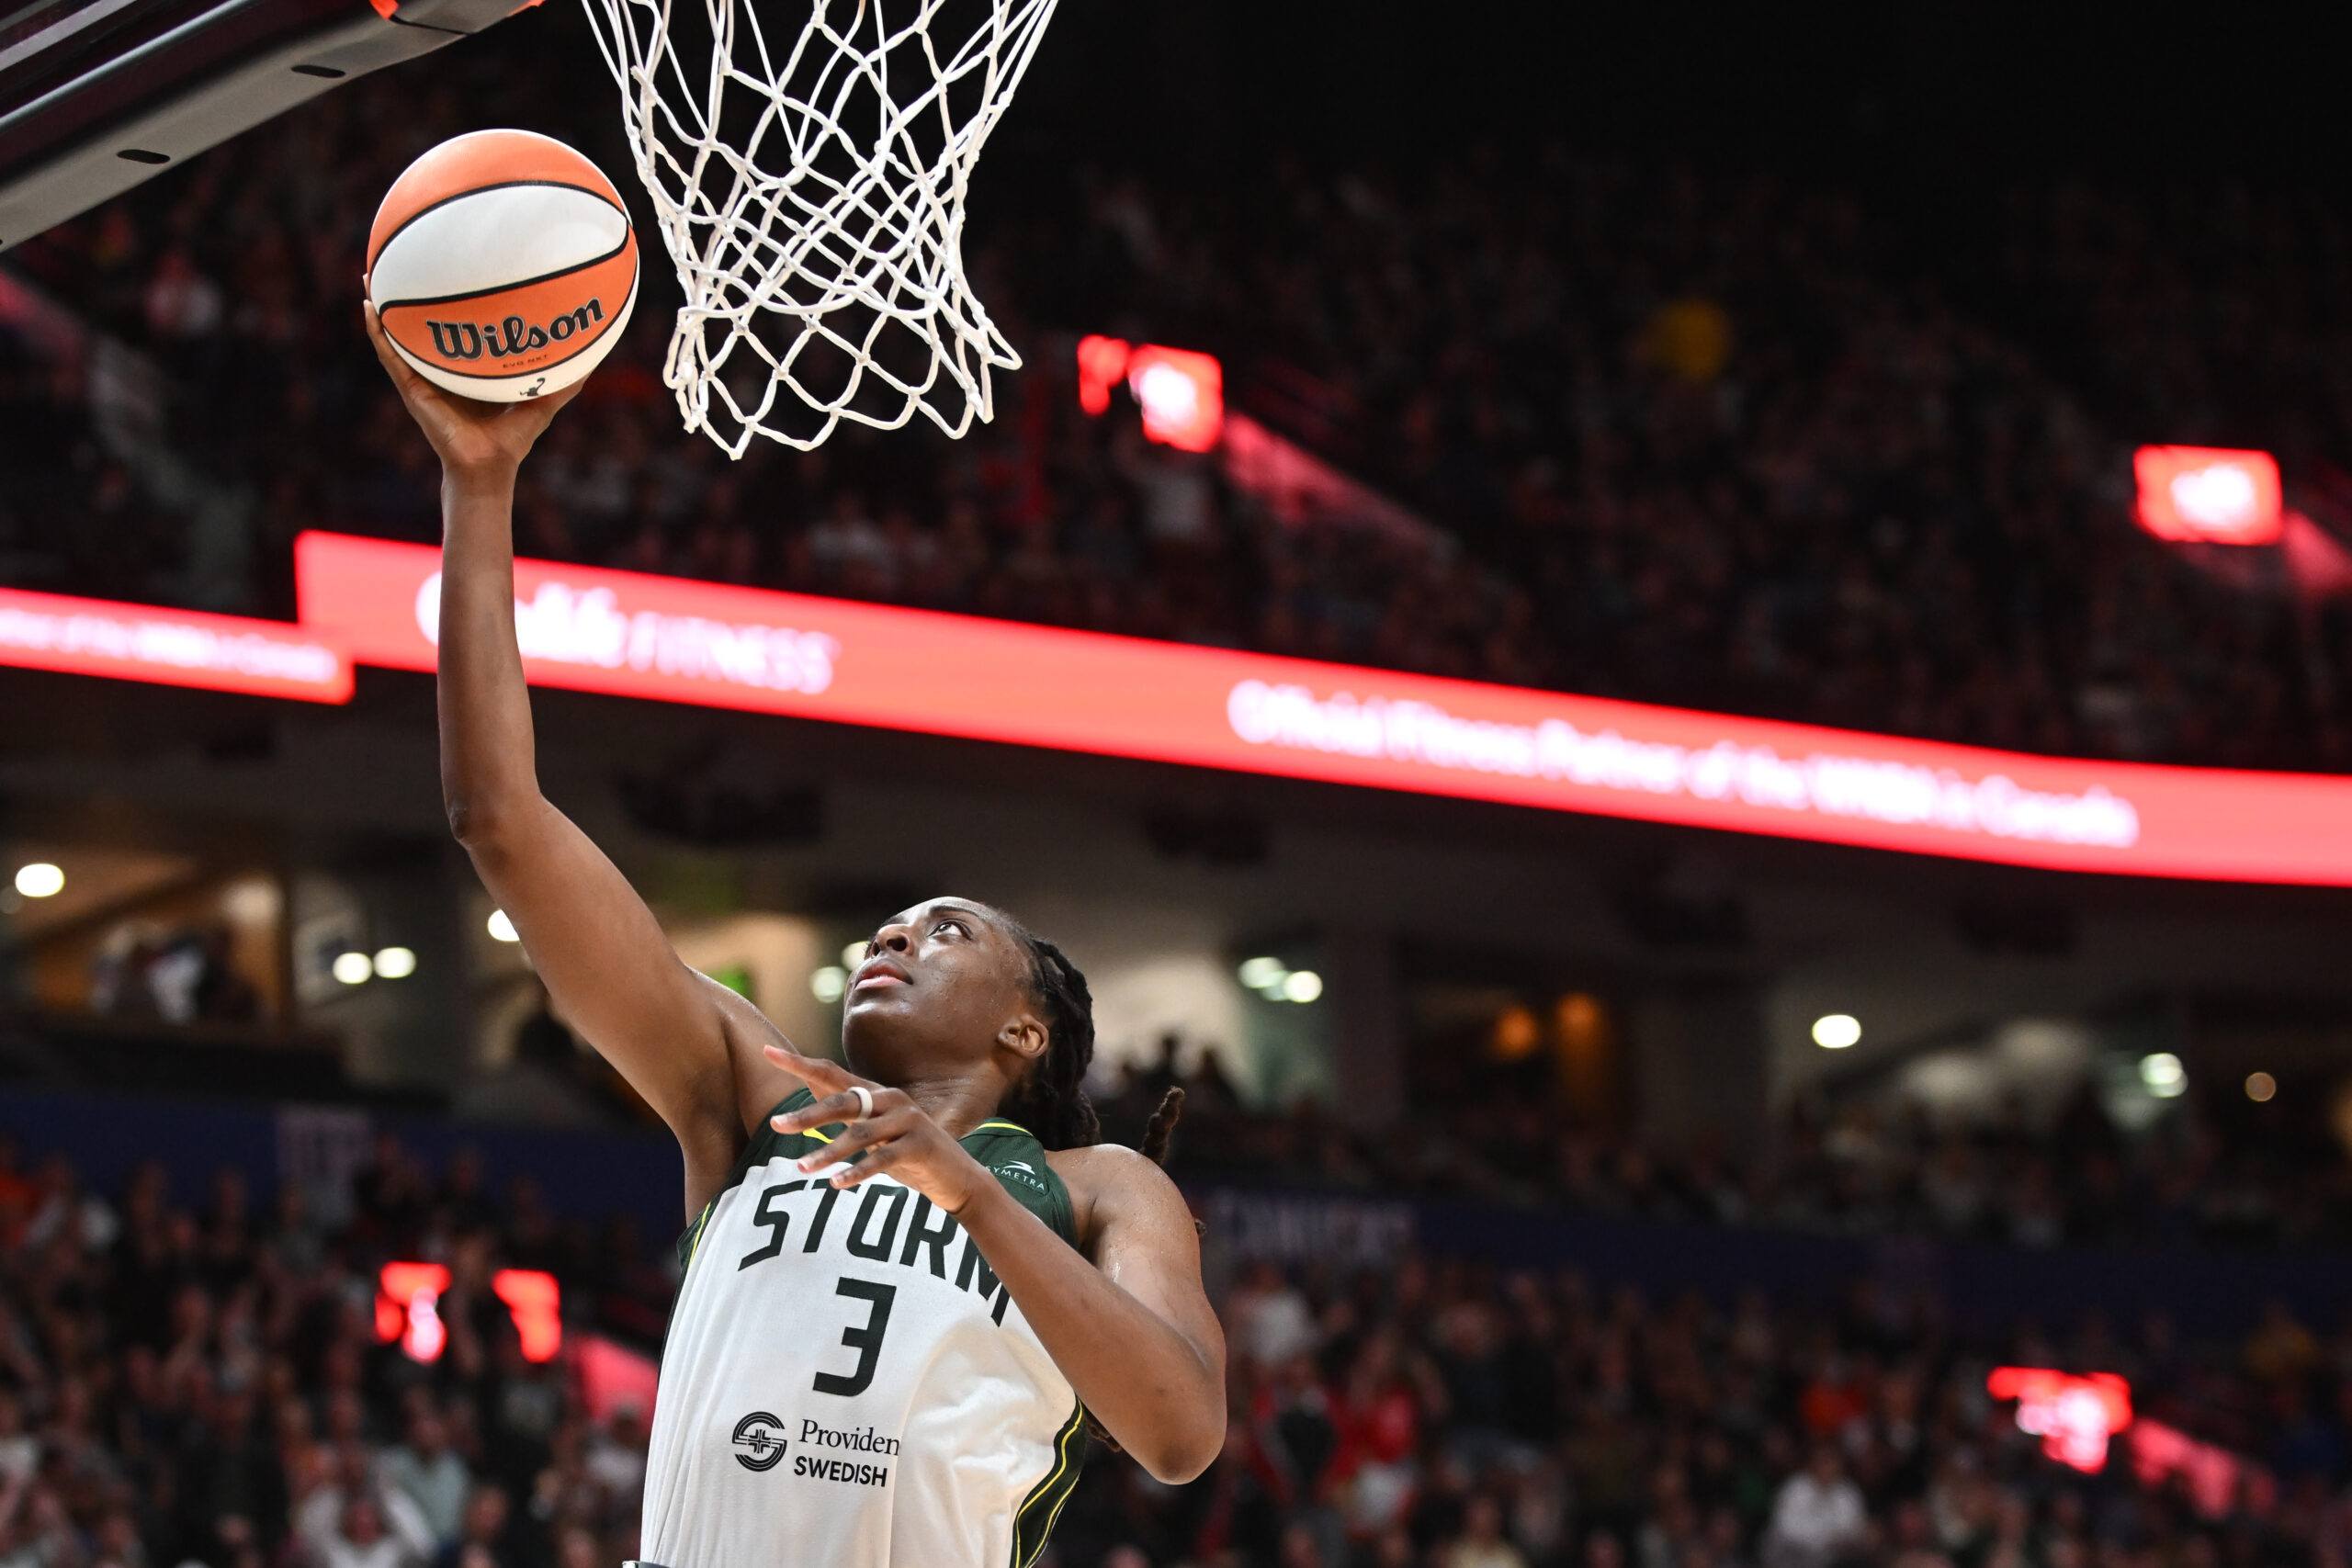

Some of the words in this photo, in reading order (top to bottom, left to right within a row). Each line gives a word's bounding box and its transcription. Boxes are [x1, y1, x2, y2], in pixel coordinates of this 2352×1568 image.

[425, 298, 606, 361] Wilson
[812, 1277, 898, 1397] 3
[794, 1456, 888, 1488] SWEDISH
